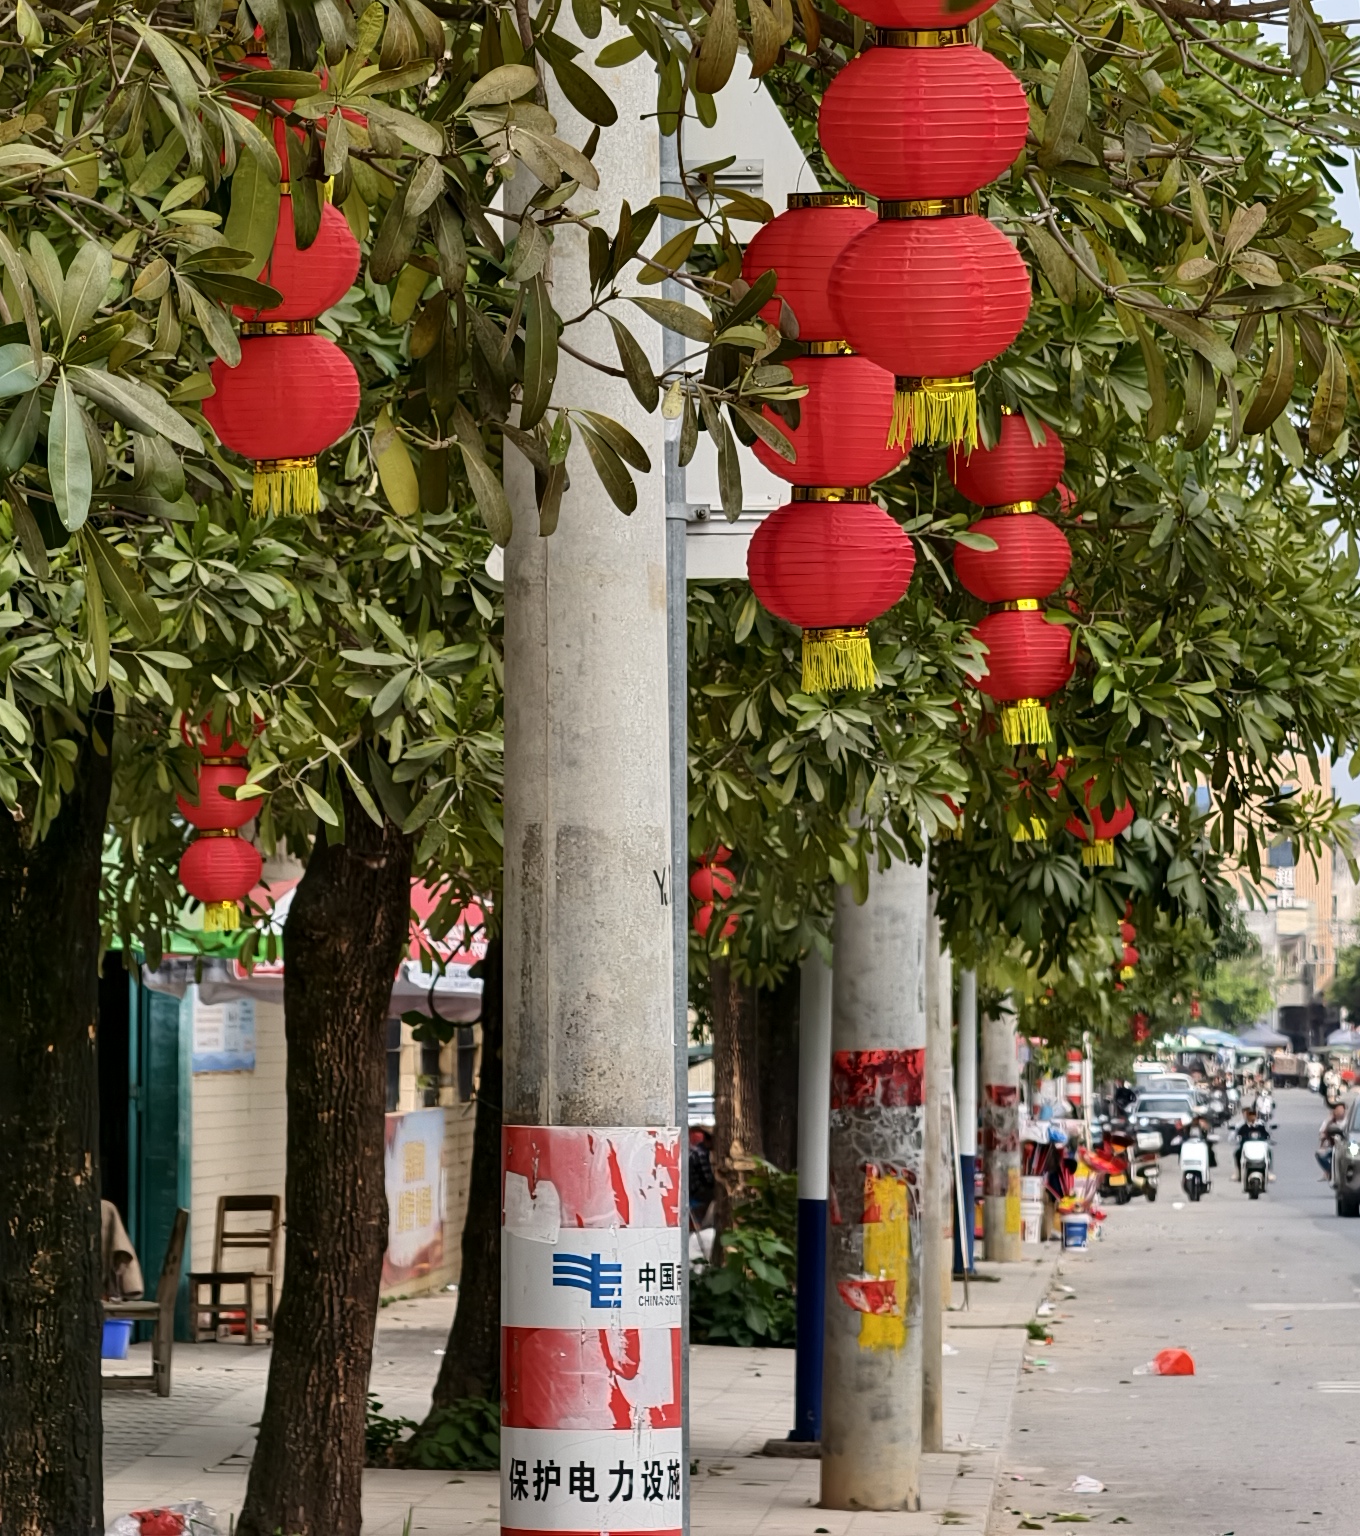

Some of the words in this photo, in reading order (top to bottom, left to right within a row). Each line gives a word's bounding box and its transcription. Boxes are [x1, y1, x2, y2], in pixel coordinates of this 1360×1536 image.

[638, 1295, 663, 1306] CHINA
[509, 1458, 680, 1503] 保护电力设施
